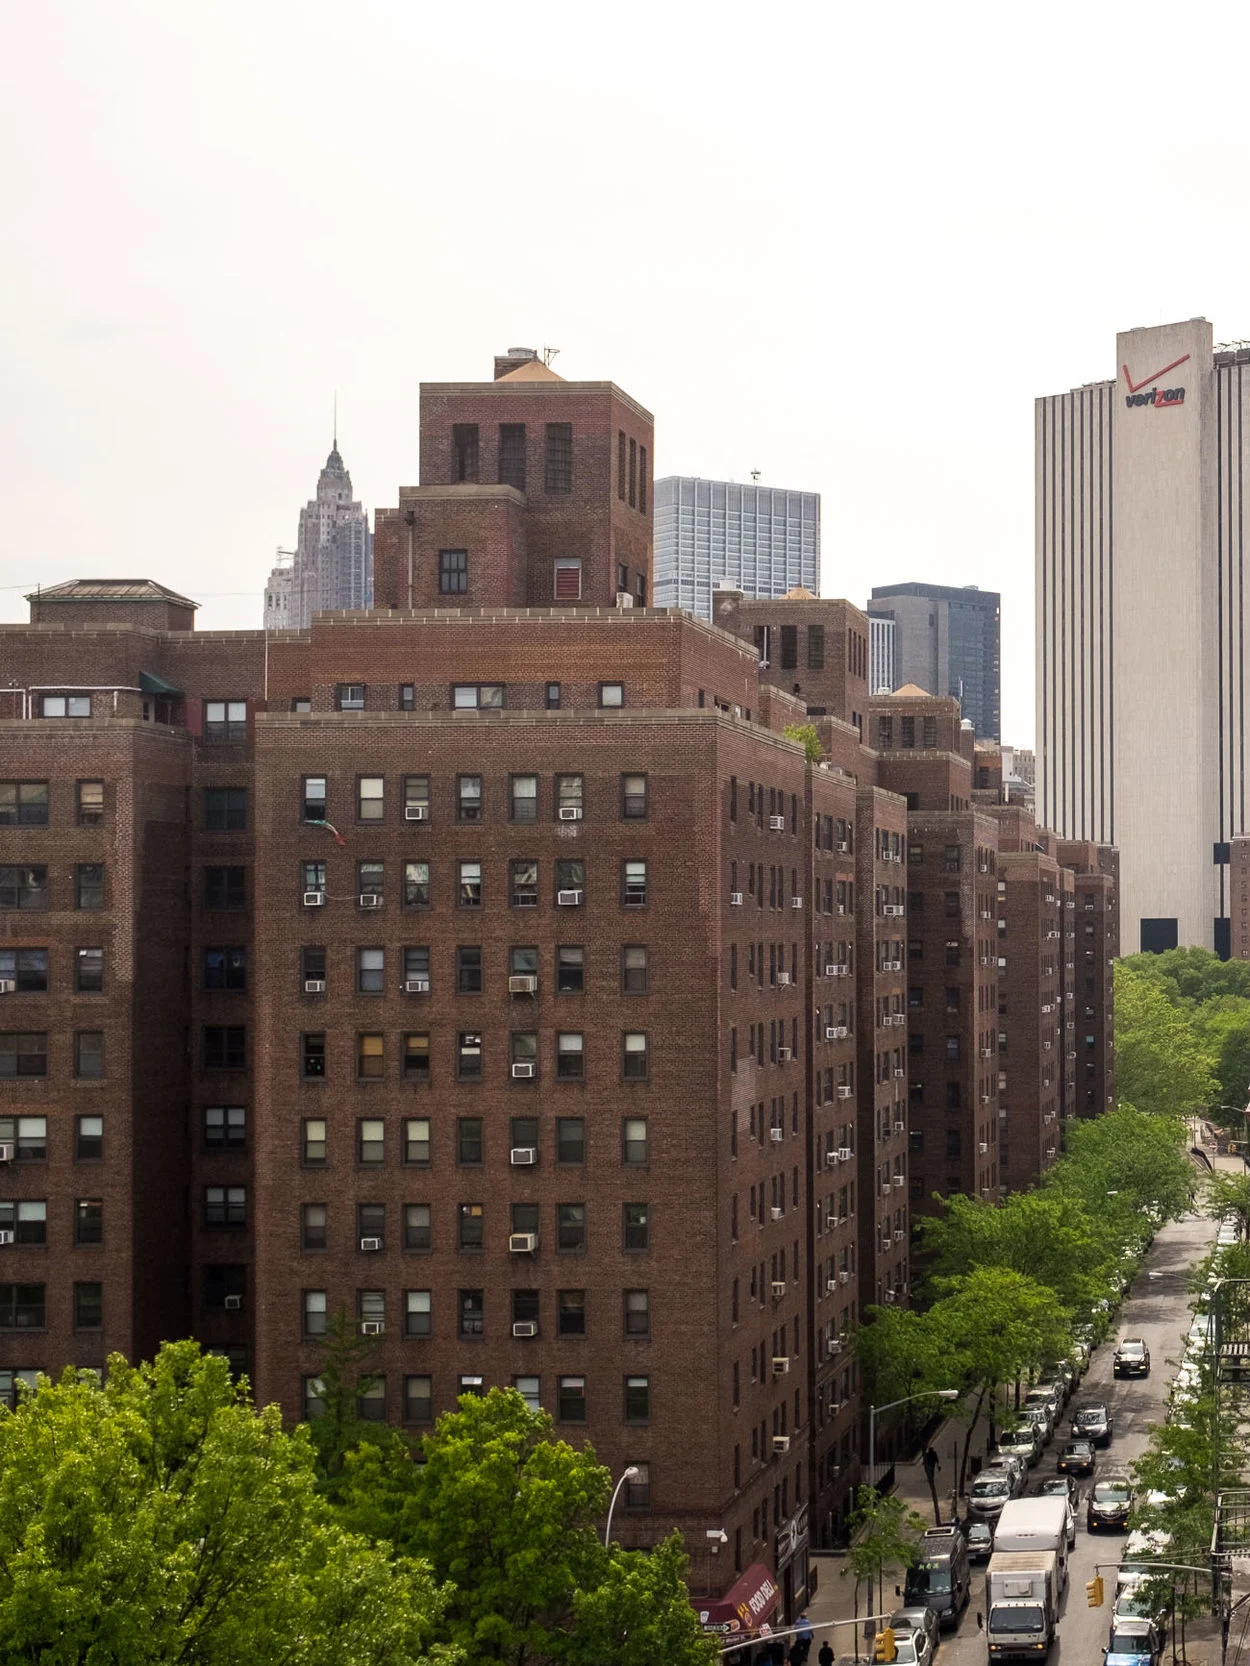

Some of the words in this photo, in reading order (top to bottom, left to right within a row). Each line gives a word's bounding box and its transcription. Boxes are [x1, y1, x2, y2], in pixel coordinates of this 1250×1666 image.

[1125, 386, 1186, 408] verizon
[748, 1590, 767, 1615] FOOD
[759, 1579, 775, 1601] DELI
